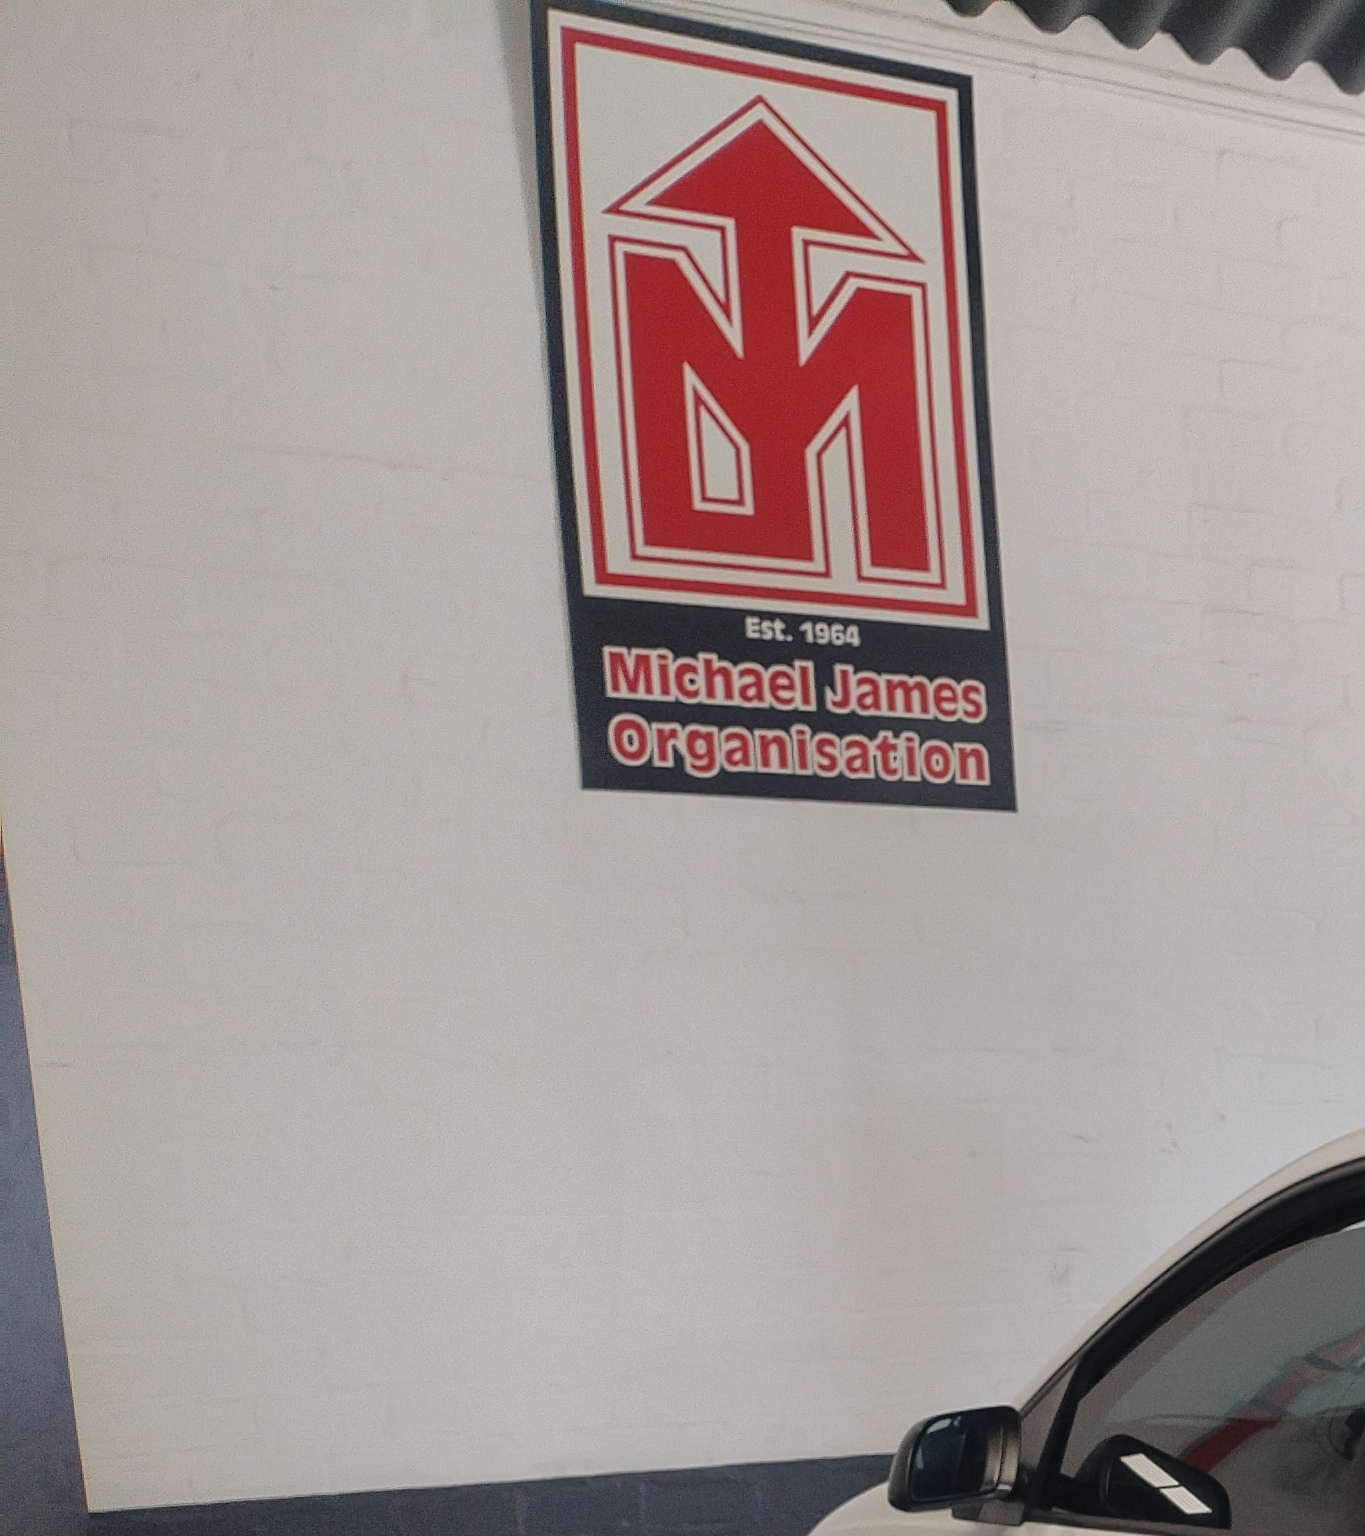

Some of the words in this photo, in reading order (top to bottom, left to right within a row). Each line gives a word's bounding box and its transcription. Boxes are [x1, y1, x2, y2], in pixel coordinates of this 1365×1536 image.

[745, 616, 793, 642] Est.
[800, 621, 861, 647] 1964
[602, 645, 817, 712] Michael
[825, 663, 988, 723] James
[608, 712, 991, 787] Organisation
